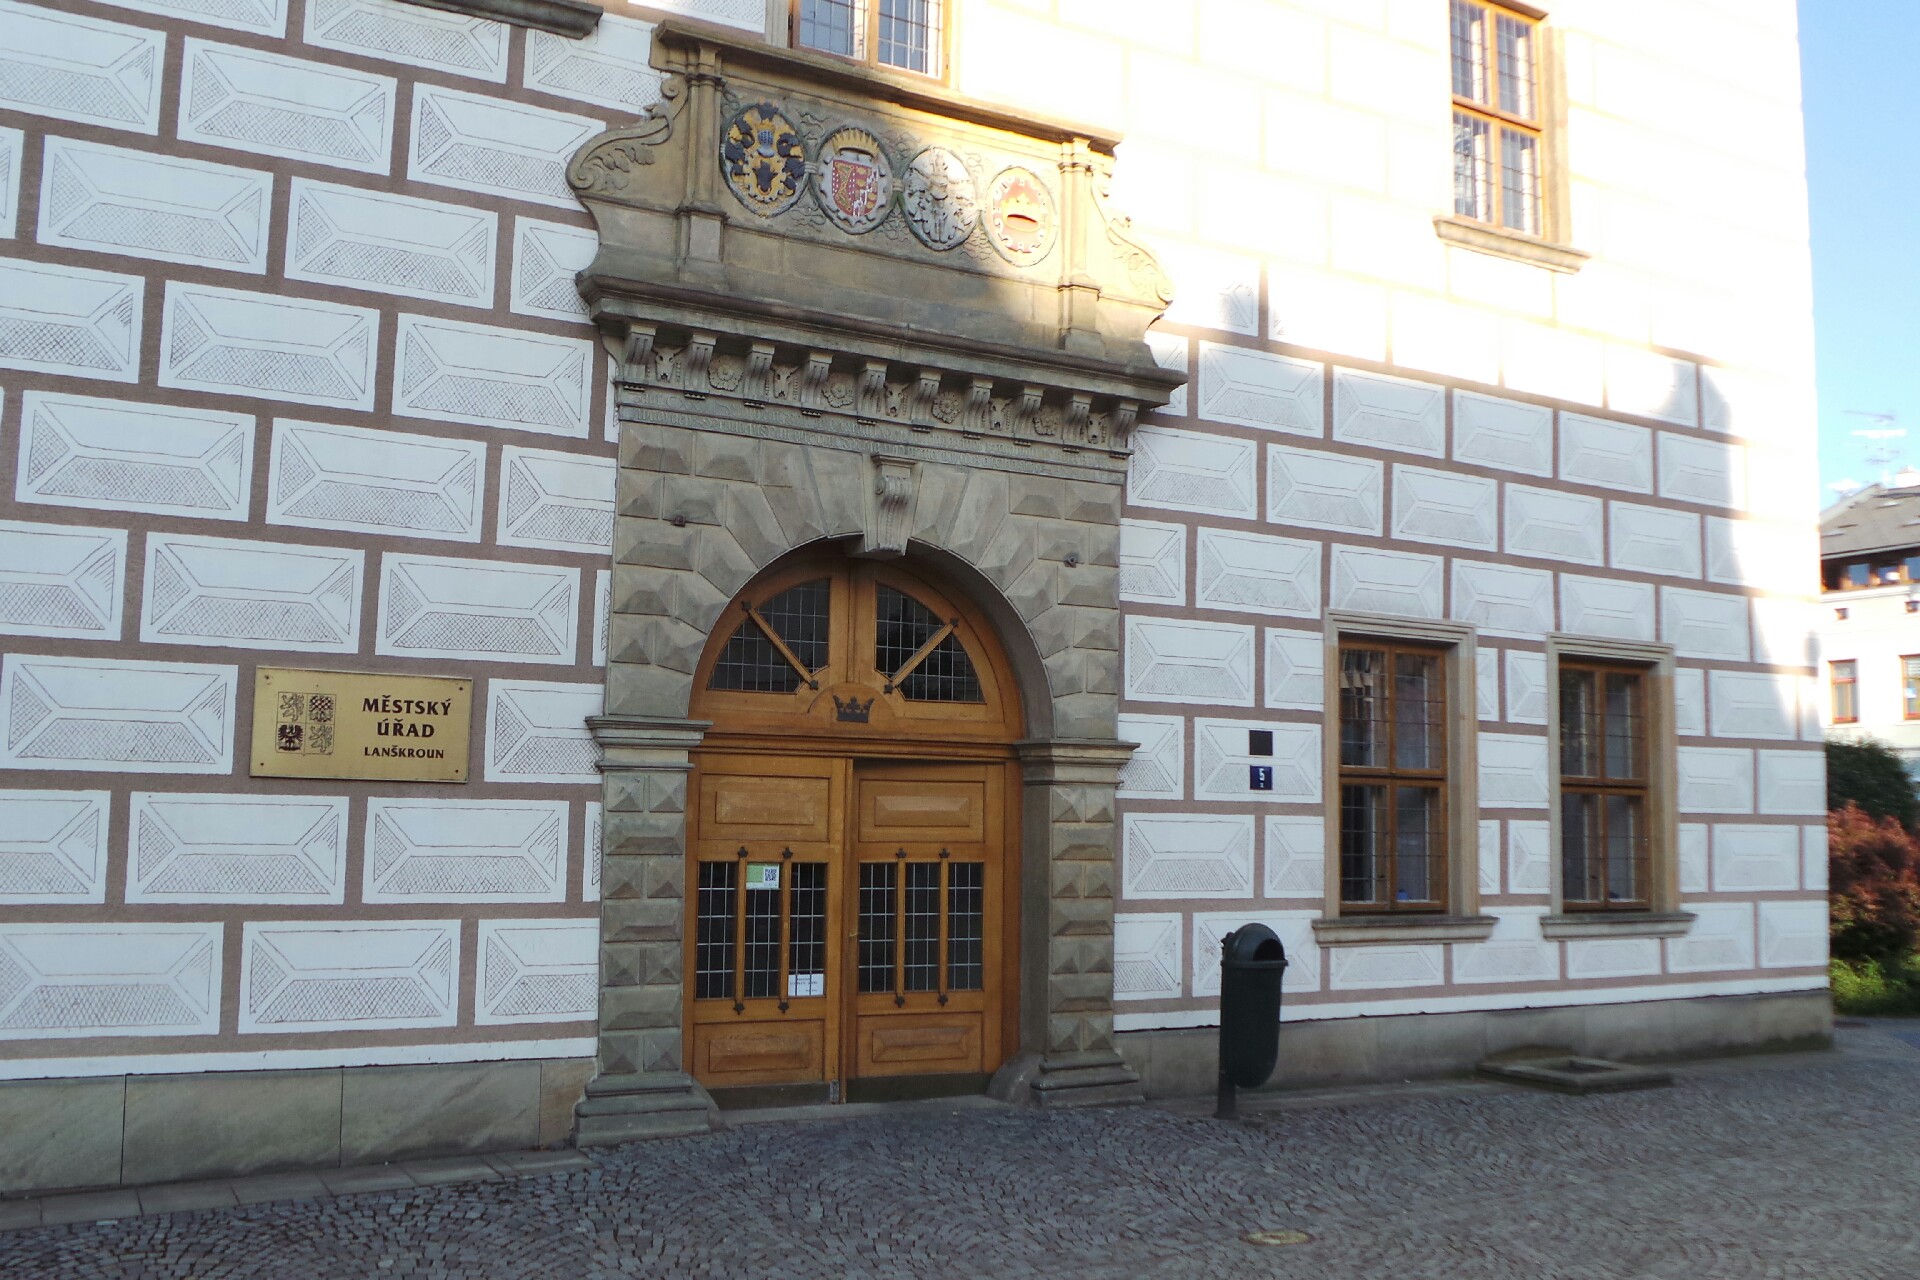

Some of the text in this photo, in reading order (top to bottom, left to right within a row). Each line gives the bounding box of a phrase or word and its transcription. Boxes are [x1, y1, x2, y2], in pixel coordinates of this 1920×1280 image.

[362, 695, 452, 716] MĚSTSKÝ
[377, 718, 435, 738] ÚŘAD
[364, 745, 444, 759] LANŠKROUN
